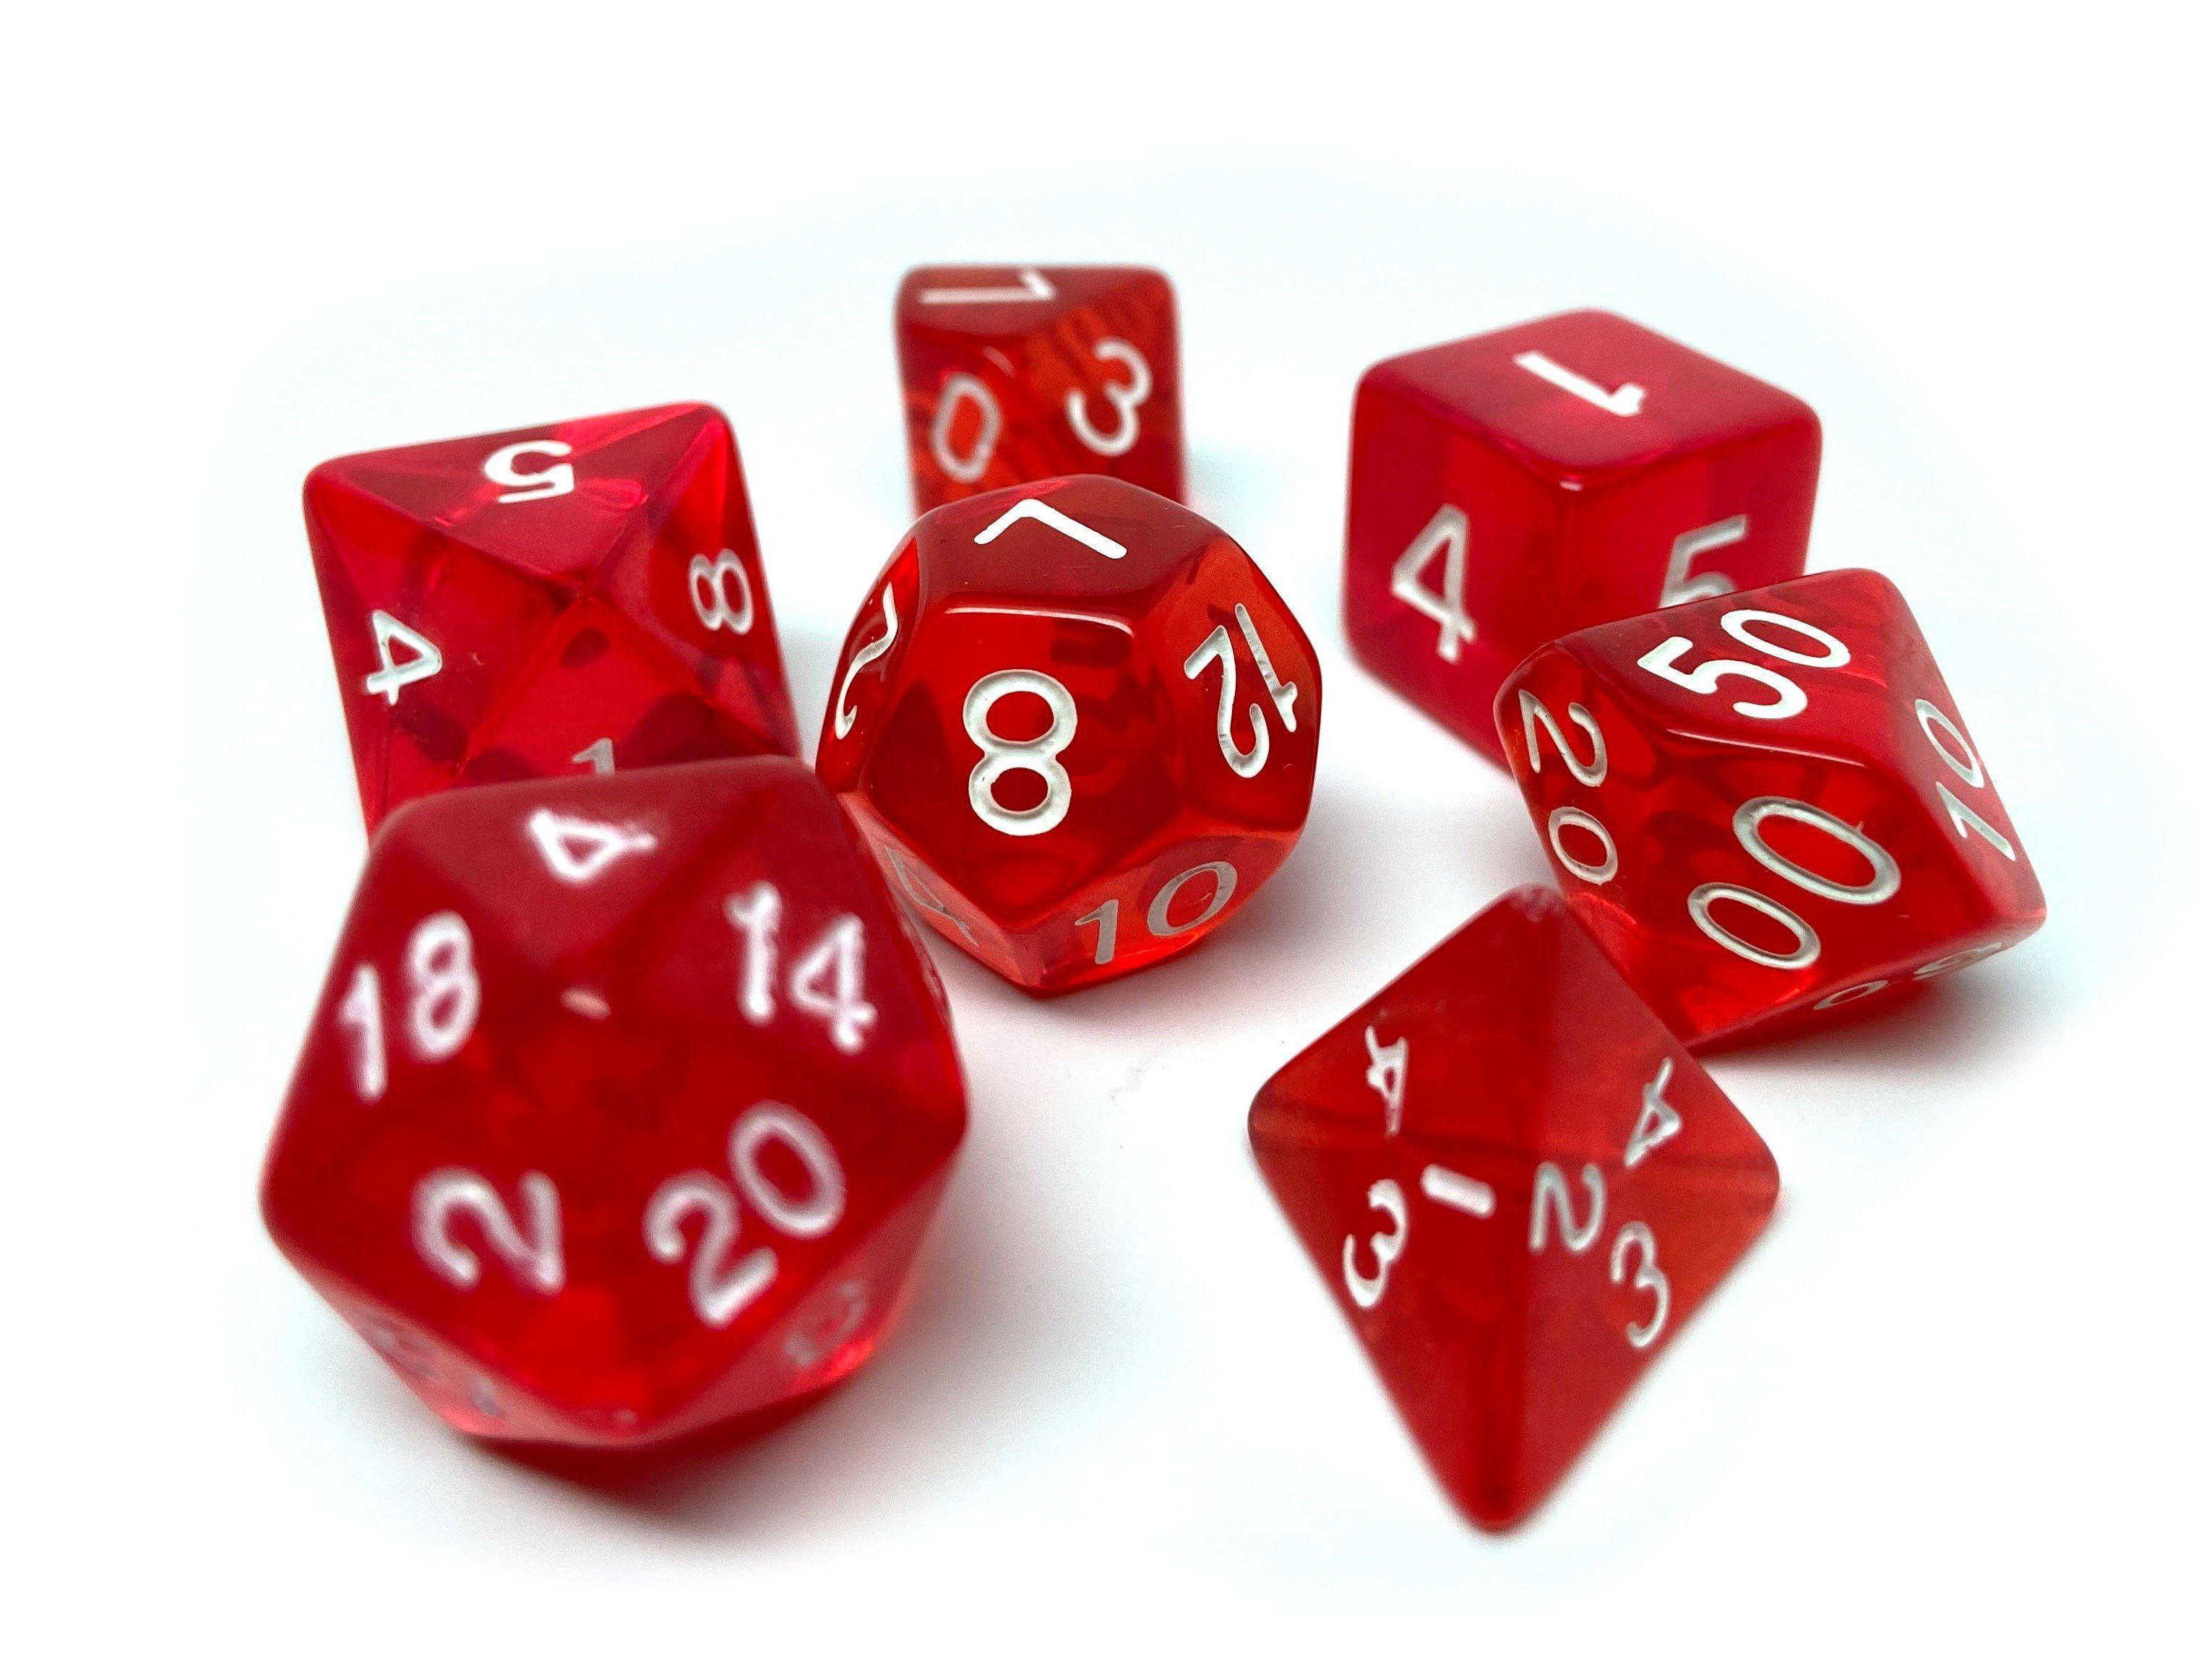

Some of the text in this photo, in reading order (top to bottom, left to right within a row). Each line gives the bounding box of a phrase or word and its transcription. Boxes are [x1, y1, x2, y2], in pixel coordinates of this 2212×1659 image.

[931, 371, 1002, 483] 0
[1065, 337, 1153, 457] 3
[1512, 348, 1647, 418] 1
[484, 439, 574, 504] 5
[973, 499, 1127, 559] 7
[689, 547, 754, 634] 8
[1391, 502, 1476, 665] 4
[1658, 513, 1747, 609] 5
[363, 609, 442, 706] 4
[1184, 603, 1297, 778] 12
[1637, 609, 1851, 719] 50
[963, 669, 1077, 837] 8
[1518, 689, 1618, 885] 20
[1914, 698, 2015, 861] 10
[523, 806, 659, 885] 4
[1687, 796, 1901, 970] 00
[725, 879, 878, 1056] 14
[1075, 861, 1238, 965] 10
[341, 908, 481, 1101] 18
[1364, 1025, 1409, 1137] 4
[1626, 1056, 1684, 1168] 4
[413, 1165, 567, 1297] 2
[642, 1100, 847, 1331] 20
[1342, 1178, 1410, 1310] 3
[1528, 1162, 1606, 1254] 2
[1610, 1220, 1671, 1350] 3
